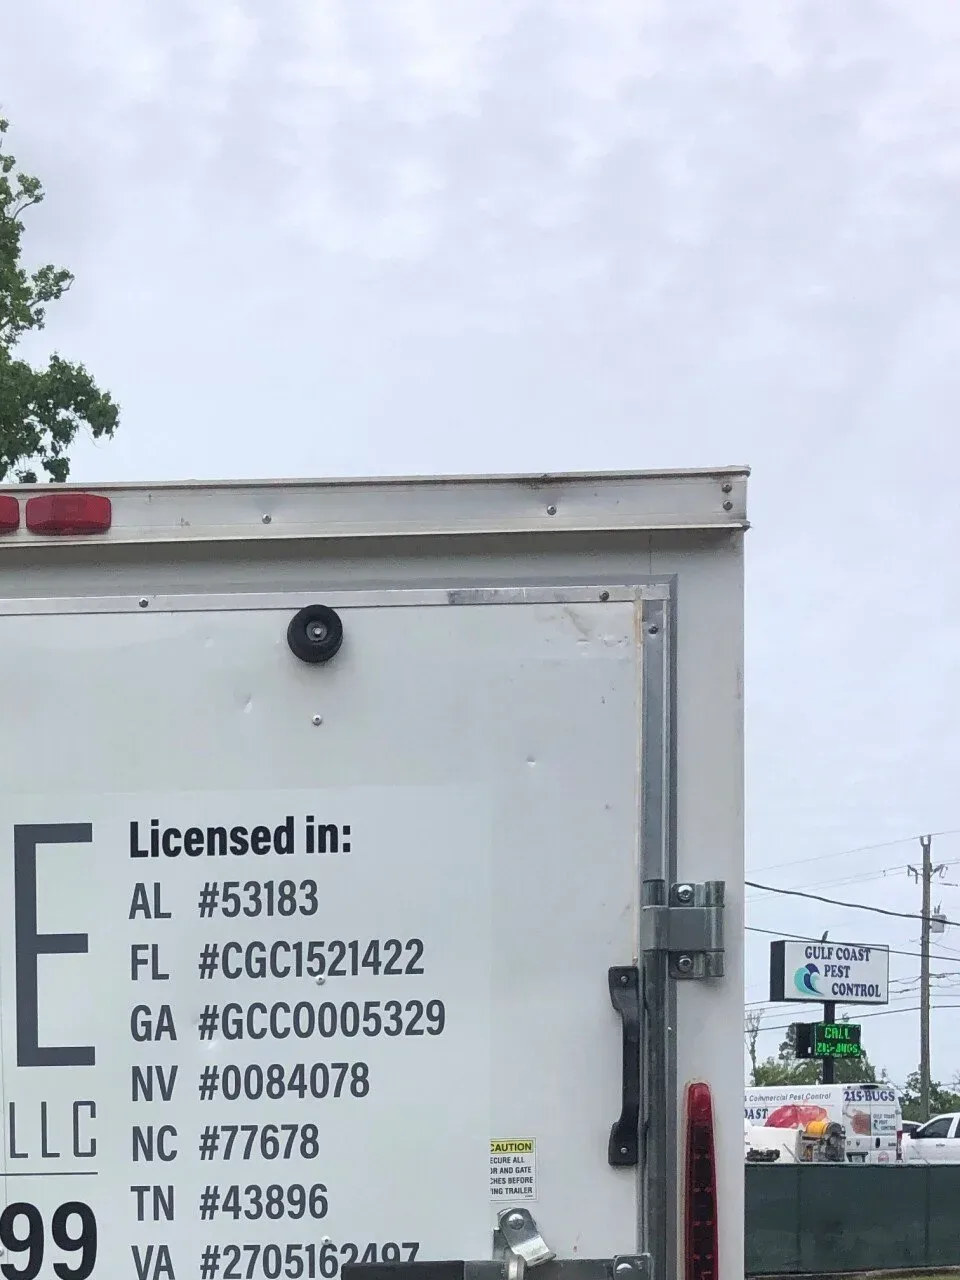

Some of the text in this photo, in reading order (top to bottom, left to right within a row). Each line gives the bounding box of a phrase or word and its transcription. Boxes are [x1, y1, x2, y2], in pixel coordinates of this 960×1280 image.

[130, 816, 351, 857] Licensed in:
[129, 880, 318, 919] AL #53183
[131, 939, 424, 980] FL #CGC1521422
[805, 946, 871, 961] GULF COAST
[824, 964, 850, 978] PEST
[832, 983, 881, 997] CONTROL
[131, 1004, 177, 1041] GA
[131, 1062, 369, 1101] NV #0084078
[10, 1101, 96, 1158] LLC
[132, 1123, 319, 1161] NC #77678
[131, 1183, 328, 1221] TN #43896
[131, 1245, 176, 1280] VA
